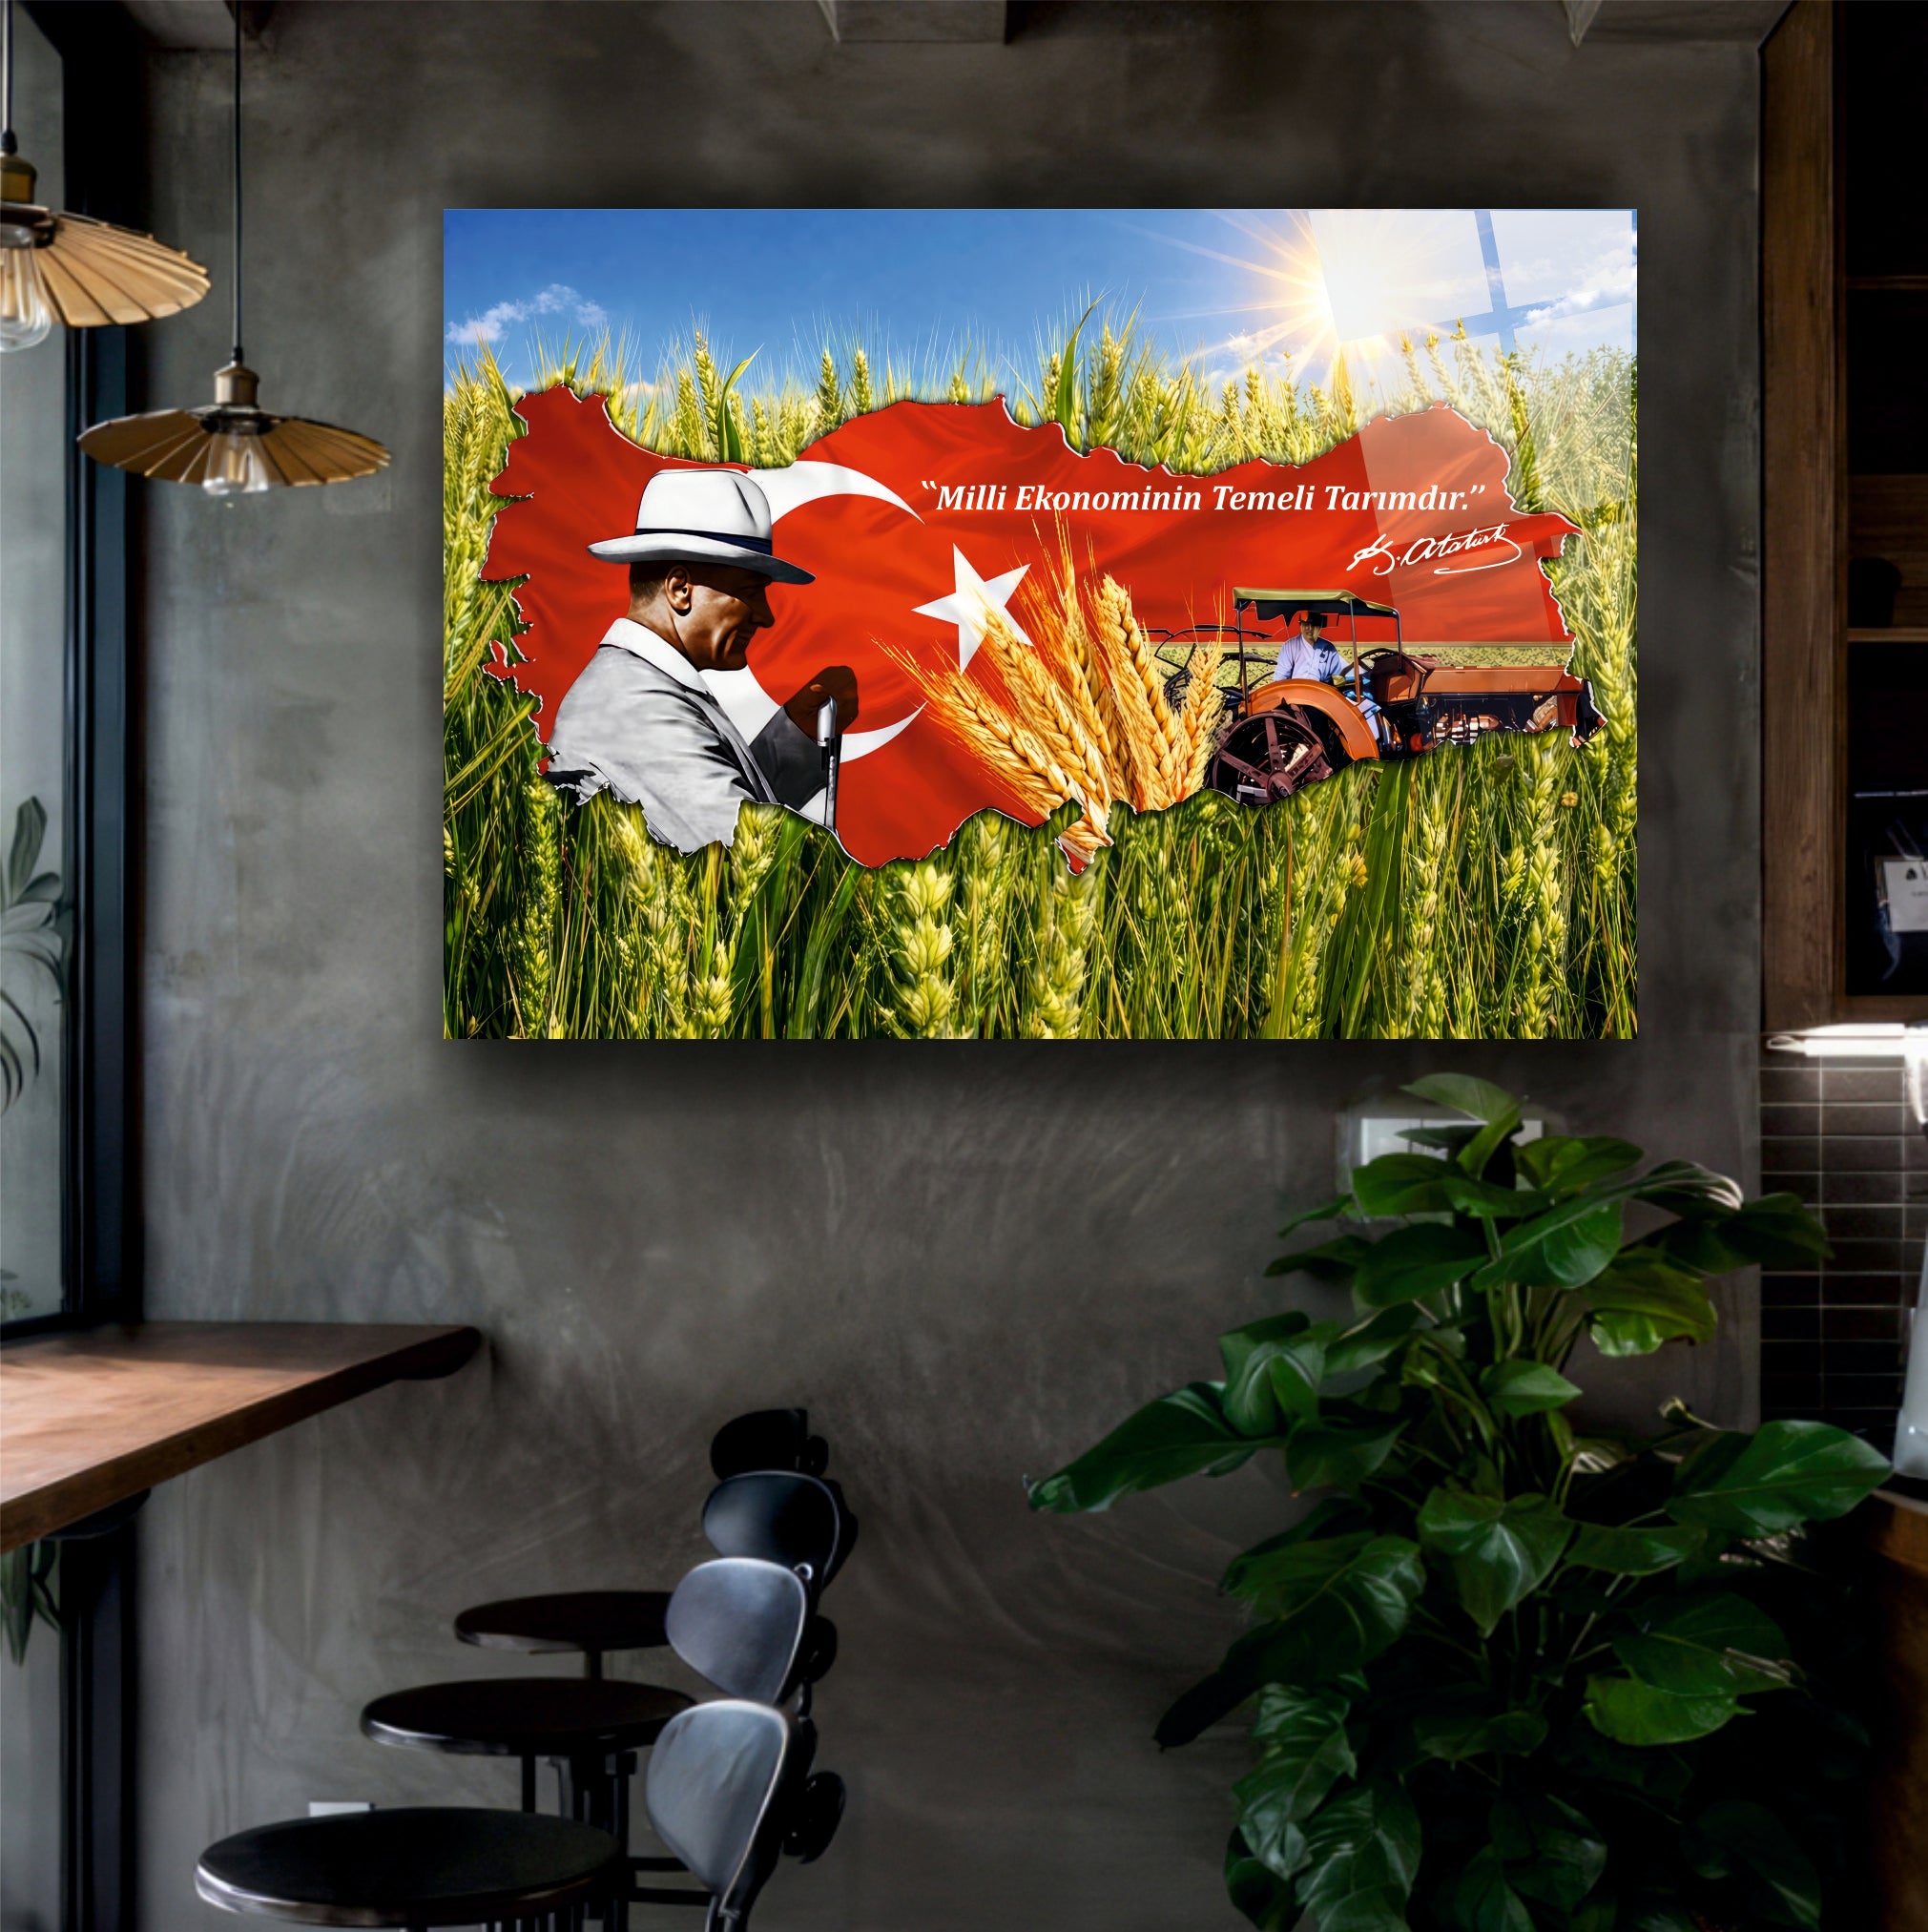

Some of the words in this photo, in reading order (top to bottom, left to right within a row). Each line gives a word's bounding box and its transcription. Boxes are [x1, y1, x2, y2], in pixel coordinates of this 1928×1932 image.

[921, 480, 1007, 510] “Milli
[1013, 485, 1202, 511] Ekonominin
[1213, 485, 1316, 511] Temeli
[1324, 484, 1486, 511] Tarımdır.”
